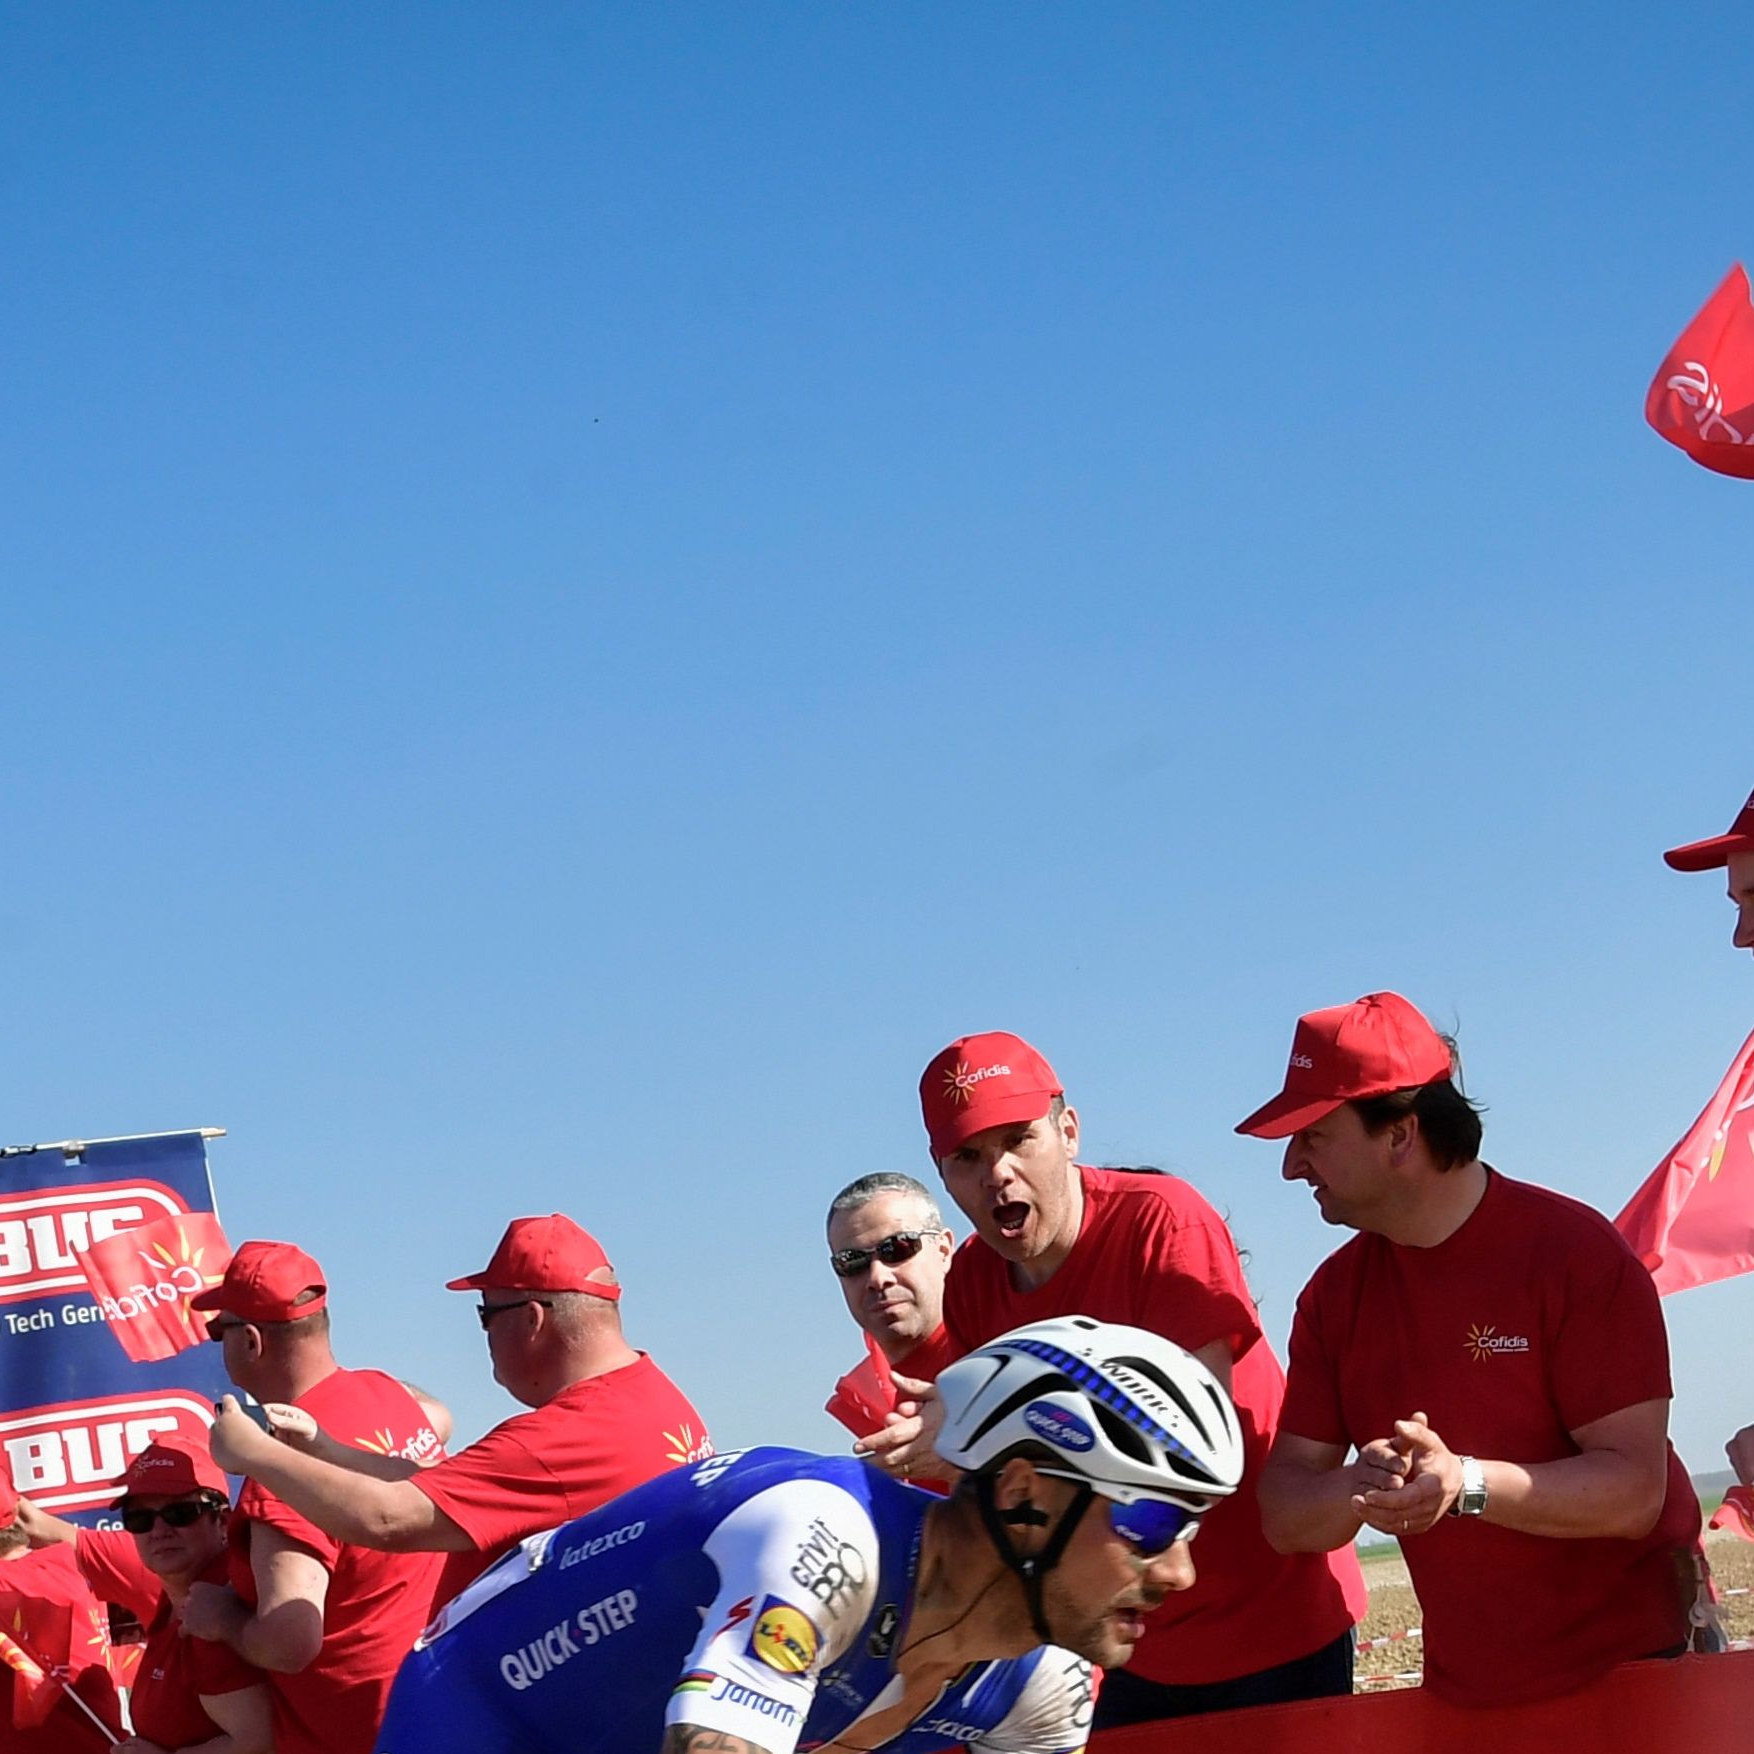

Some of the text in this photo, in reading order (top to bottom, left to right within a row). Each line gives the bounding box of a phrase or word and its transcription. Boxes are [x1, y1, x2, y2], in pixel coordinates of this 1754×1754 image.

[955, 1064, 1012, 1088] Cofidis
[5, 1310, 55, 1337] Tech
[1477, 1336, 1529, 1348] Cofidis
[559, 1520, 646, 1571] latexco
